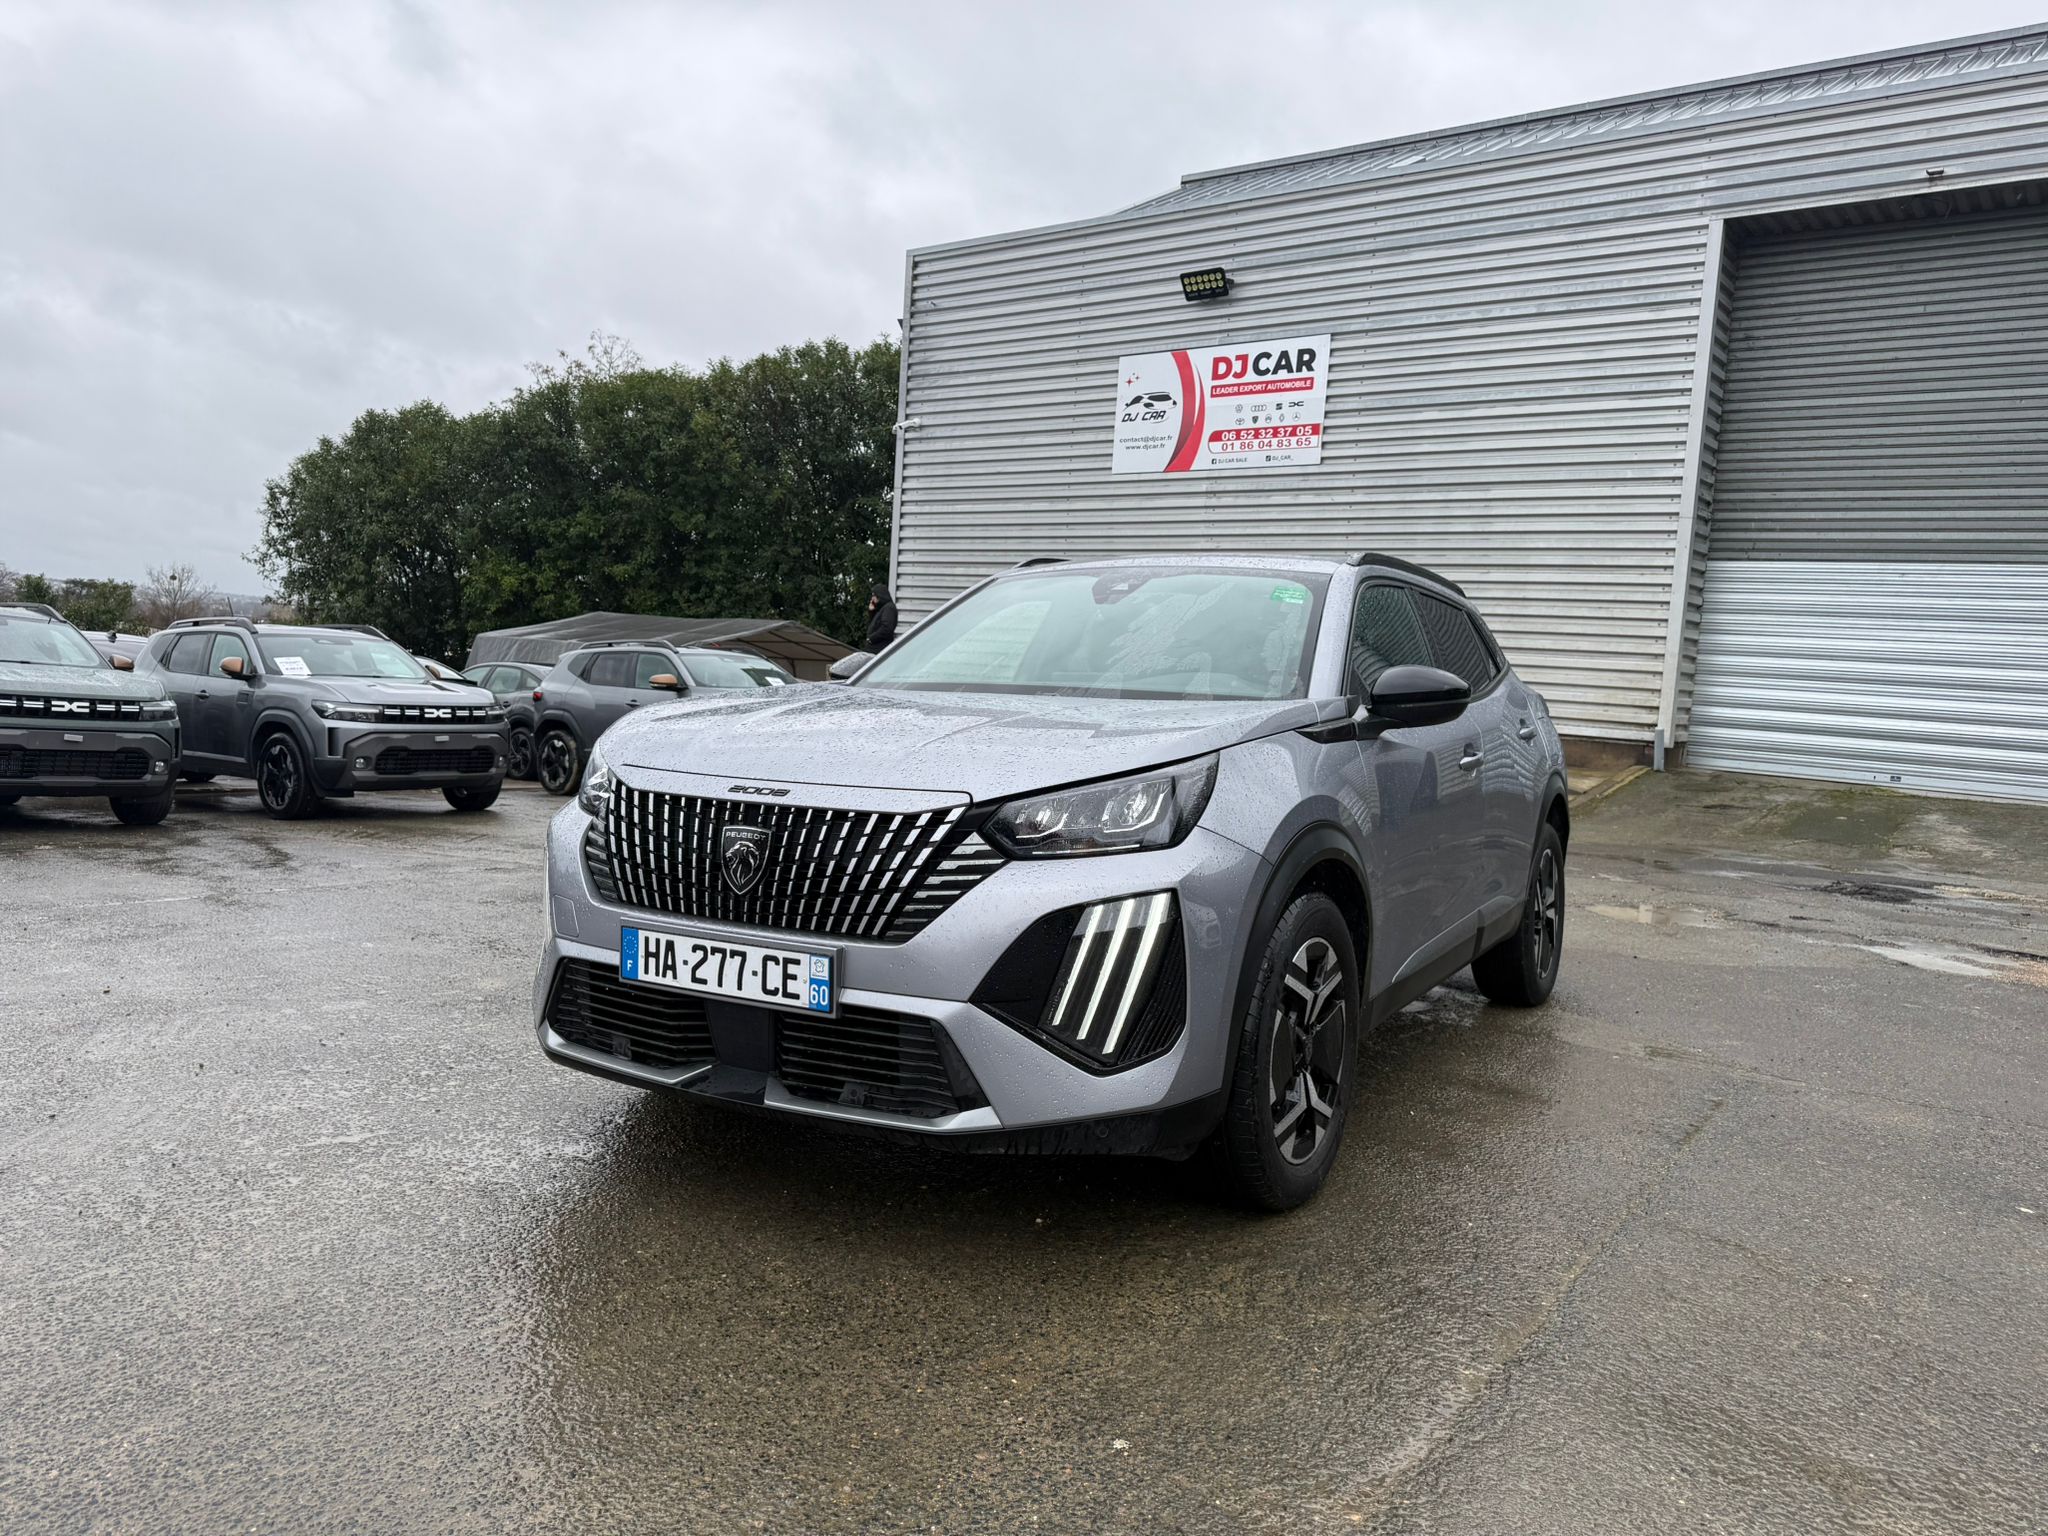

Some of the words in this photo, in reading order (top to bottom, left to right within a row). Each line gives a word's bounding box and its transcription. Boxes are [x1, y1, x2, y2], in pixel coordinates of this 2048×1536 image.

[1212, 354, 1249, 381] DJ
[1252, 348, 1316, 376] CAR
[1212, 386, 1239, 395] LEADER
[1239, 383, 1266, 393] EXPORT
[1266, 380, 1311, 391] AUTOMOBILE
[1121, 412, 1139, 422] DJ
[1141, 410, 1167, 421] CAR
[1119, 434, 1173, 443] contact@djcar.fr
[1221, 431, 1236, 441] 06
[1240, 430, 1255, 440] 52
[1258, 428, 1273, 438] 32
[1277, 427, 1292, 437] 37
[1296, 425, 1312, 436] 05
[1221, 442, 1235, 451] 01
[1239, 441, 1254, 450] 86
[1258, 440, 1273, 449] 04
[1276, 438, 1292, 448] 83
[1296, 437, 1312, 447] 65
[727, 785, 791, 797] 2008
[725, 831, 766, 840] PEUGEOT
[627, 960, 633, 971] F
[810, 984, 828, 1005] 60
